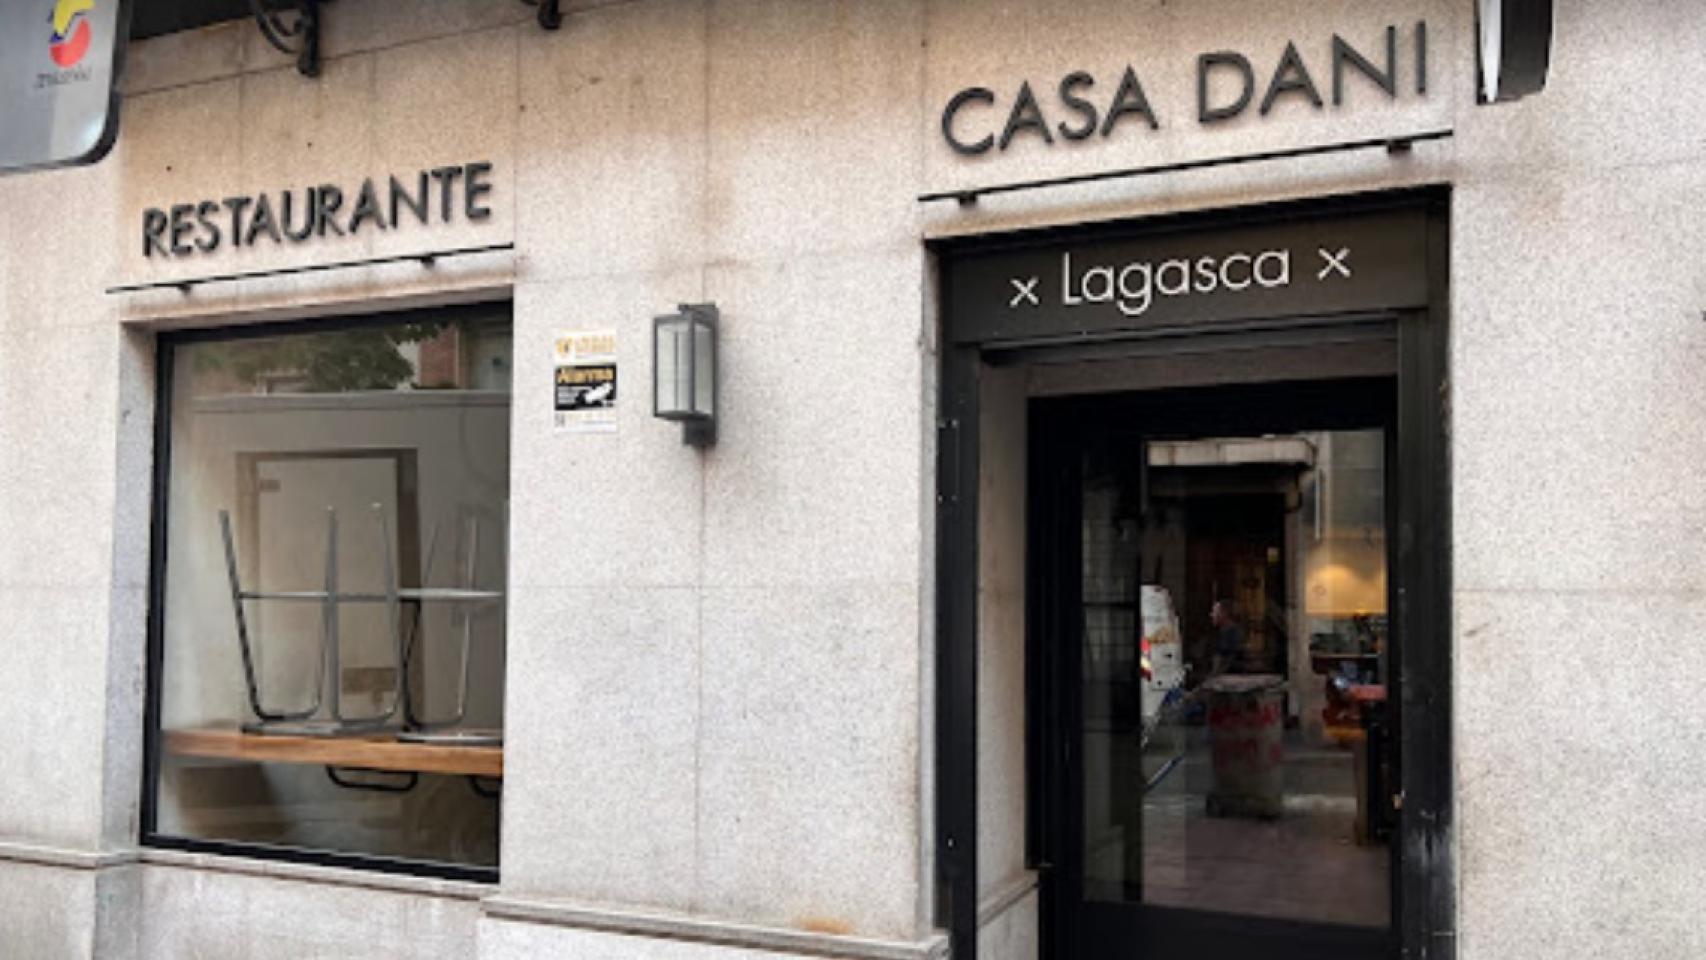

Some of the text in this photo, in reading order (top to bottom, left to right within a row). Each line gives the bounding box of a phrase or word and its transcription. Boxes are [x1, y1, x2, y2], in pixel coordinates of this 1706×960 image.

[941, 19, 1428, 157] CASA DANI
[141, 161, 493, 258] RESTAURANTE
[1062, 248, 1291, 316] Lagasca
